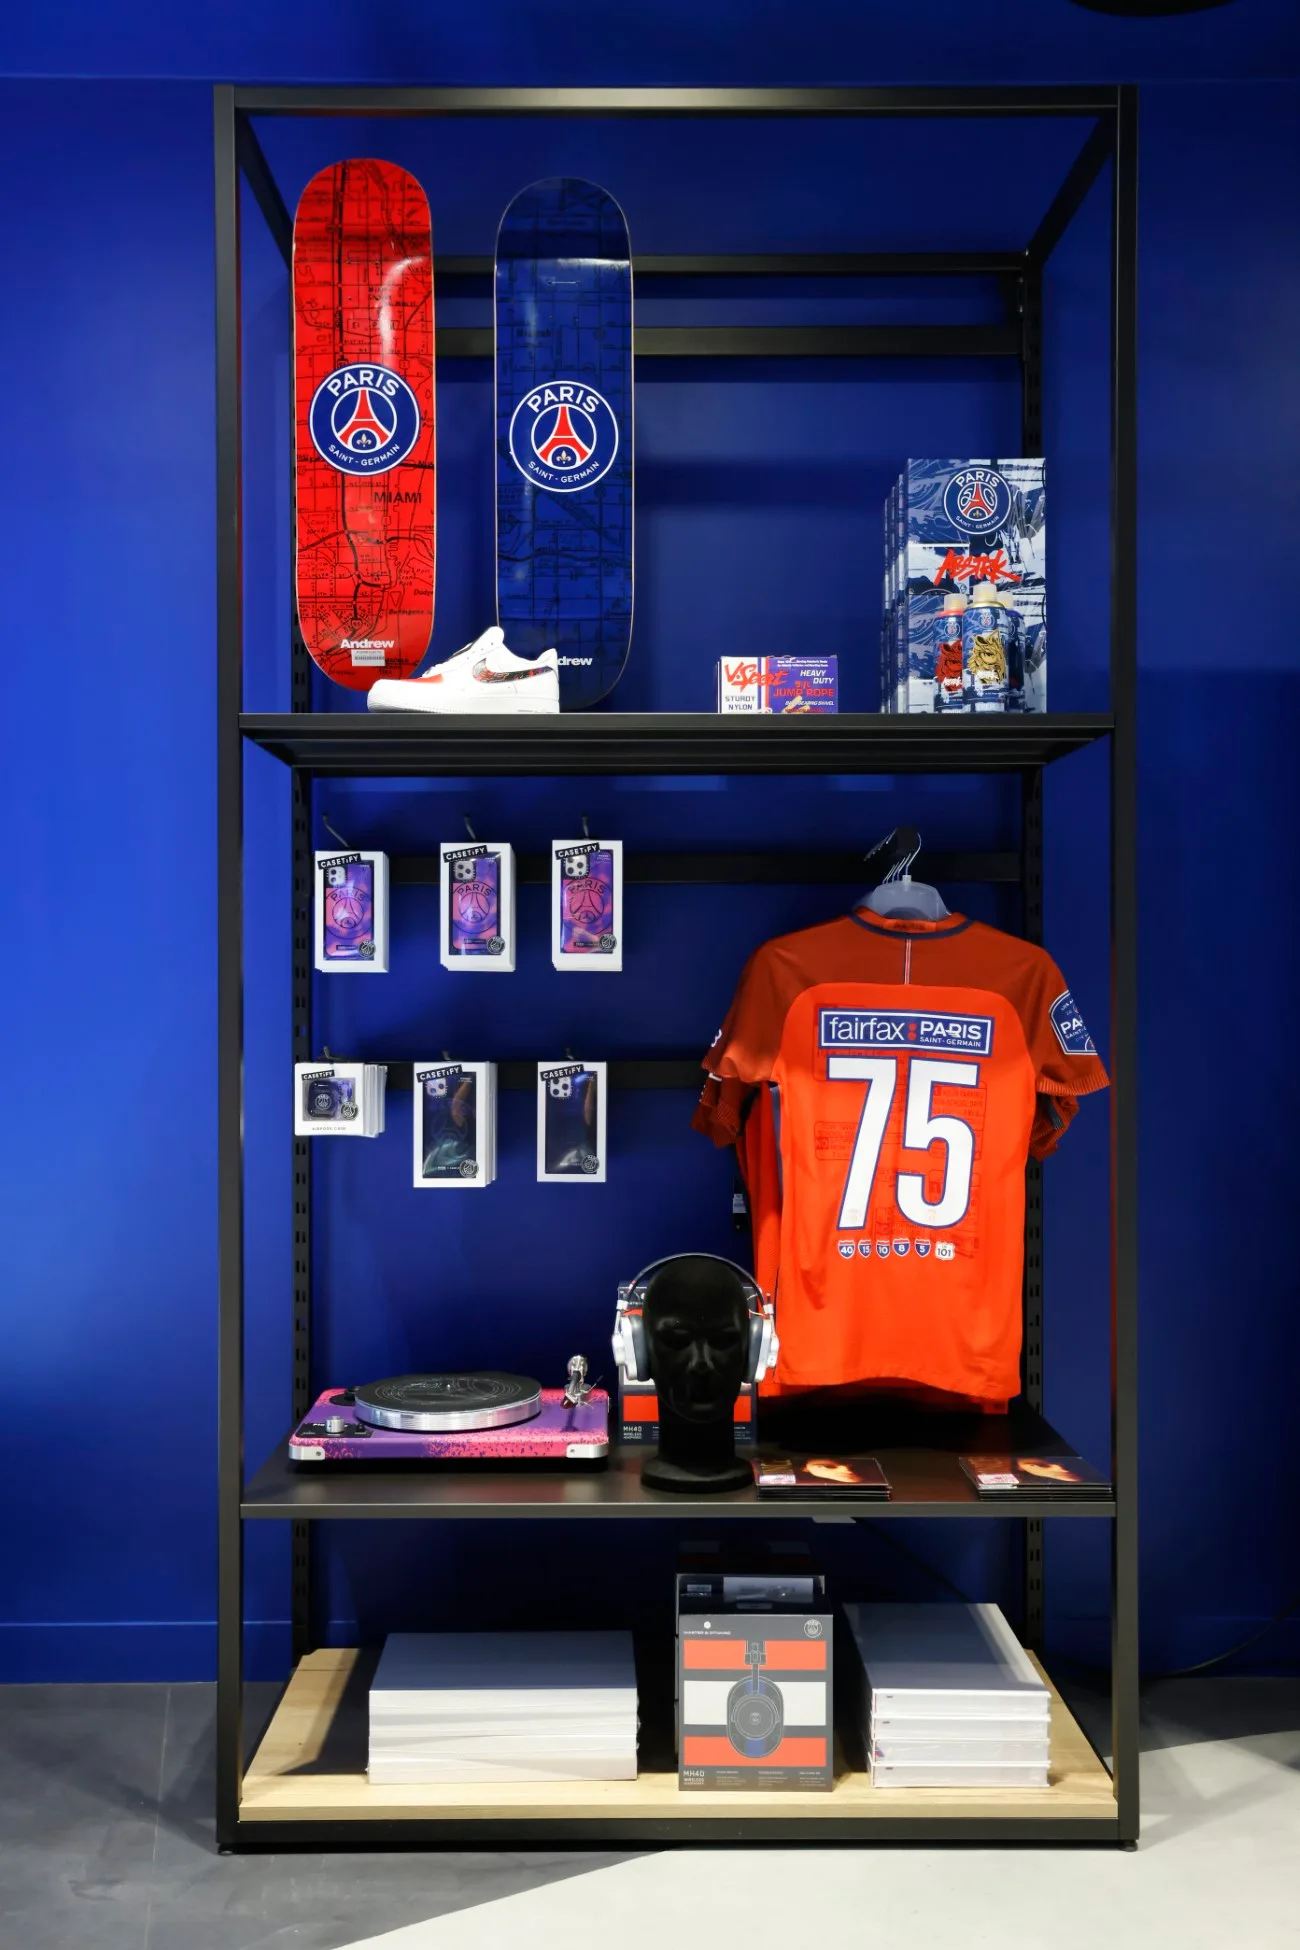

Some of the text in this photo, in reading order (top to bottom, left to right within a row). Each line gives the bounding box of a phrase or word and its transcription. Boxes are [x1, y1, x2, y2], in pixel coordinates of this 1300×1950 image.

[327, 369, 400, 397] PARIS
[527, 386, 600, 413] PARIS
[955, 471, 1000, 488] PARIS
[374, 491, 422, 504] MIAMI
[340, 639, 395, 649] Andrew
[558, 656, 594, 666] drew
[800, 669, 827, 677] HEAVY
[772, 688, 834, 697] JUMP ROPE
[457, 884, 492, 897] PARIS
[568, 880, 606, 895] PARIS
[829, 1017, 982, 1041] fairfax PARIS
[826, 1055, 980, 1230] 75
[841, 1246, 854, 1254] 40
[862, 1245, 871, 1253] 15
[878, 1246, 888, 1254] 10
[898, 1244, 905, 1252] 8
[937, 1248, 951, 1257] 101
